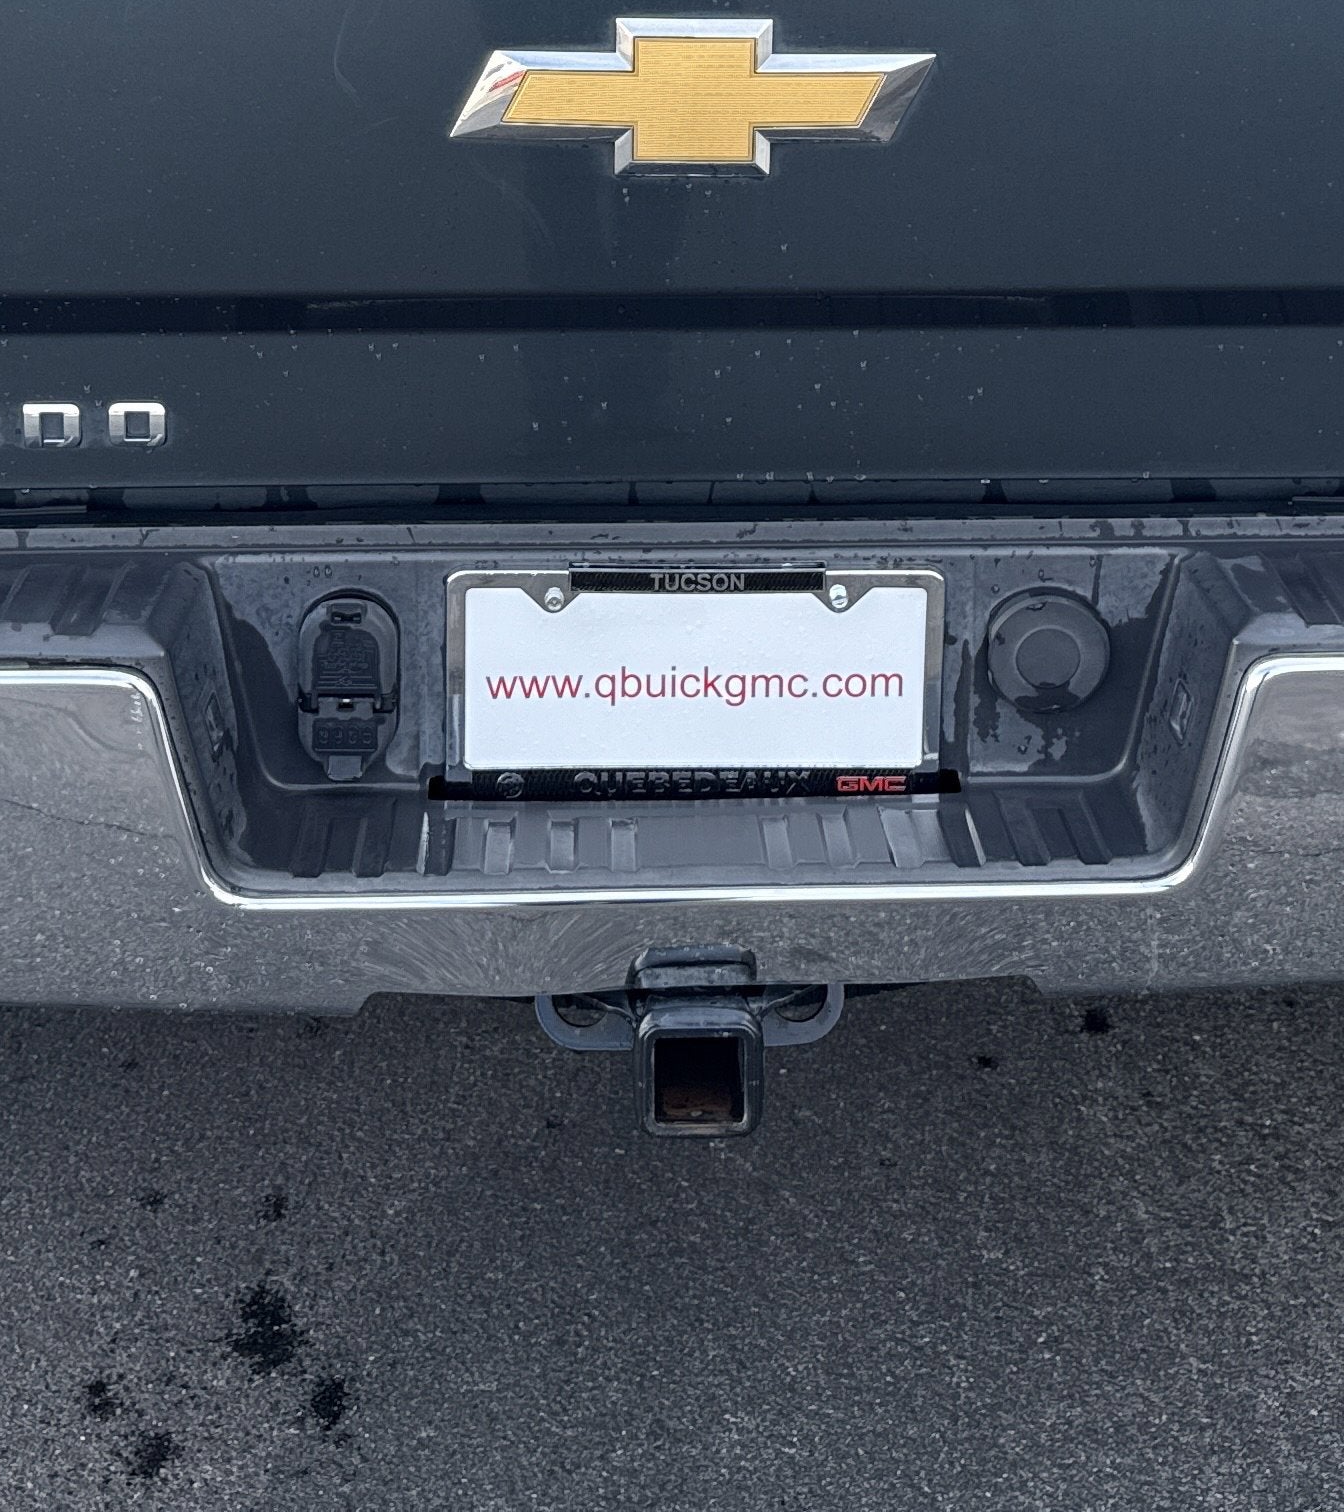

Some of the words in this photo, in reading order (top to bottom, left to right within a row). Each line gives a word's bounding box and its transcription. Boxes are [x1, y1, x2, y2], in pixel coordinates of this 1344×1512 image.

[650, 573, 746, 593] TUCSON
[485, 666, 905, 707] www.qbuickgmc.com
[572, 771, 811, 797] QUEBEDEAUX
[836, 775, 908, 793] GMC
